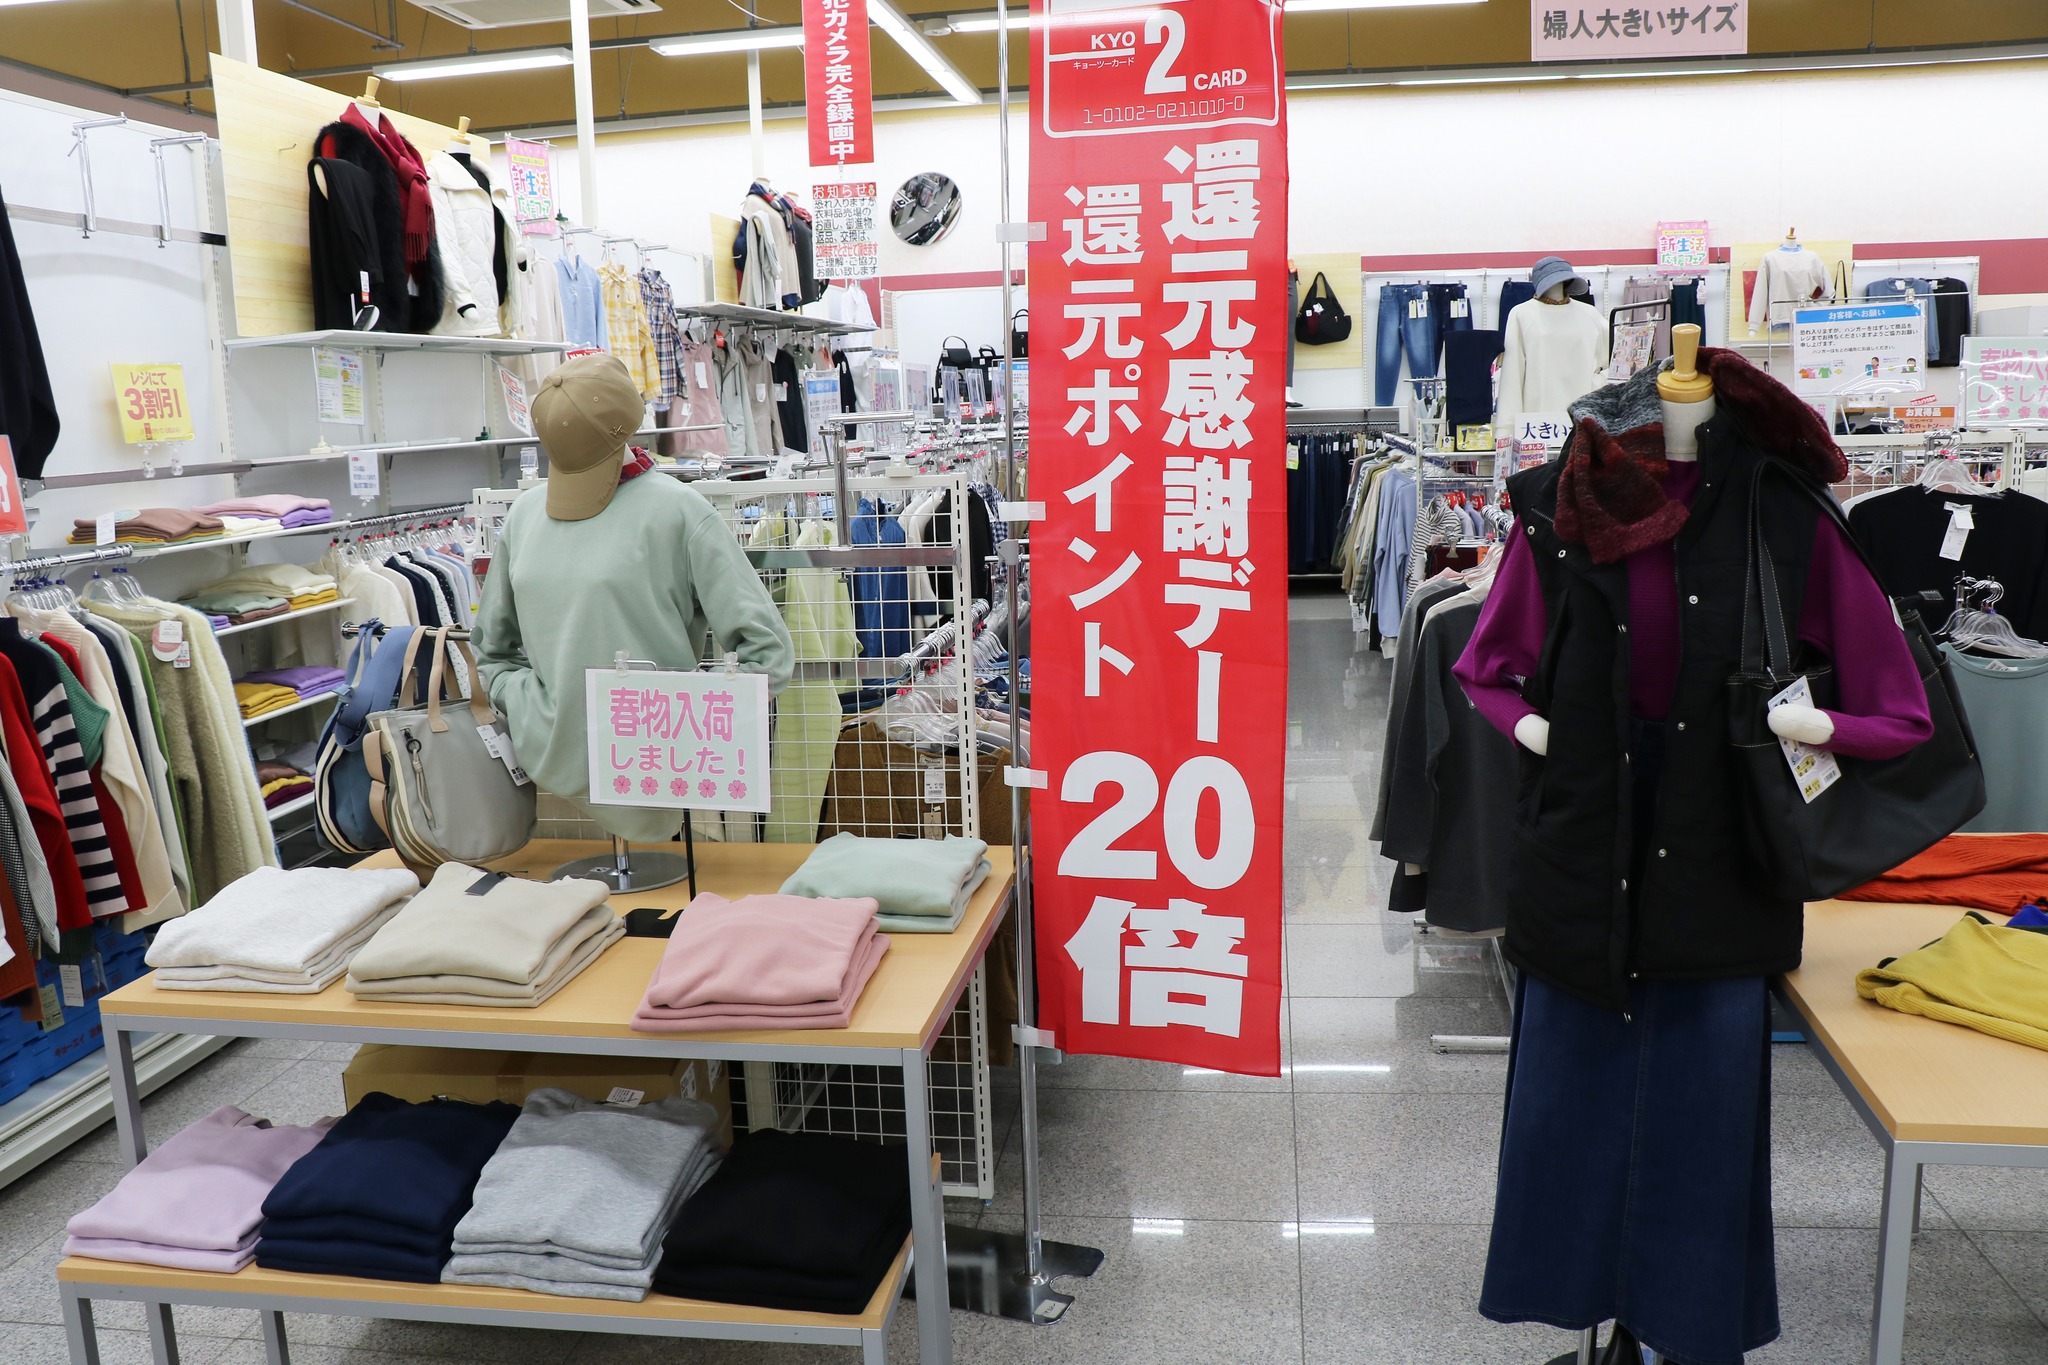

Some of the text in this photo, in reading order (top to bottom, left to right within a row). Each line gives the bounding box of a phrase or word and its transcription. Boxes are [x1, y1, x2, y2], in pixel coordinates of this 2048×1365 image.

[1543, 2, 1739, 41] 婦人大きいサイズ
[1091, 30, 1136, 50] KYO
[1073, 57, 1135, 70] キョーツーカード
[1143, 9, 1187, 95] 2
[1193, 68, 1248, 91] CARD
[1083, 95, 1245, 125] 1-0102-0211010-0
[511, 165, 548, 196] 新生活
[813, 185, 867, 199] お知らせ
[814, 197, 877, 209] 恐れ入りますが
[815, 207, 872, 219] 衣料品売場の
[1659, 236, 1705, 253] 新生活
[1661, 252, 1706, 267] 応援フェア
[817, 266, 878, 277] お願い致します
[1828, 309, 1886, 320] お客様へお願い
[1979, 348, 2048, 381] 春物入
[130, 371, 168, 386] レジにて
[124, 387, 182, 421] 3割引
[1905, 407, 1941, 417] お買得品
[1060, 183, 1145, 697] 還元ポイント
[1159, 138, 1262, 744] 還元感謝デー
[1520, 421, 1573, 440] 大きい
[610, 686, 735, 743] 春物入荷
[610, 743, 747, 777] しました！
[1057, 750, 1257, 890] 20
[1063, 895, 1251, 1040] 倍
